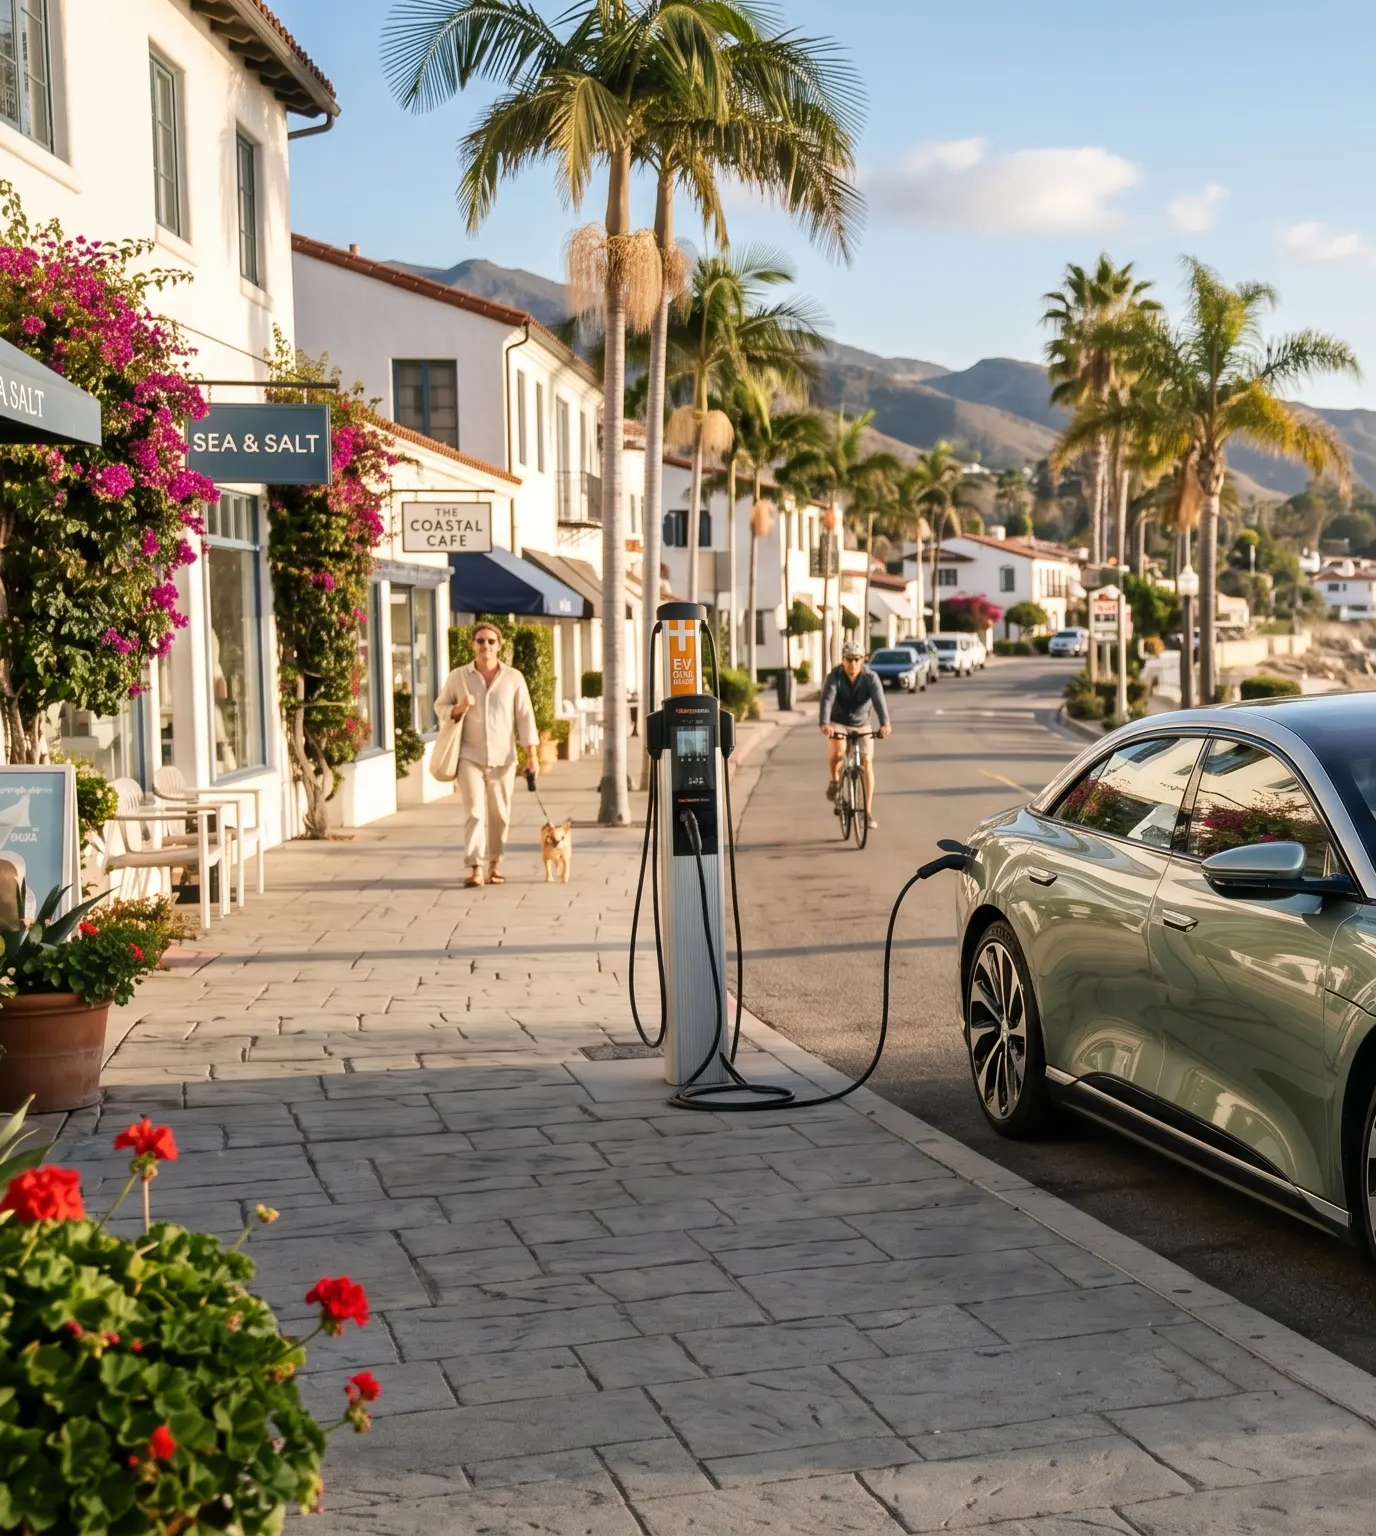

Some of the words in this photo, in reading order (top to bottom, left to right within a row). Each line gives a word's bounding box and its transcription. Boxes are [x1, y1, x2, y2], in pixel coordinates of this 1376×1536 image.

[10, 380, 45, 418] SALT
[193, 432, 238, 453] SEA
[243, 433, 260, 453] &
[264, 434, 320, 453] SALT
[435, 508, 459, 517] THE
[410, 520, 483, 532] COASTAL
[426, 535, 468, 547] CAFE
[673, 658, 692, 670] EV
